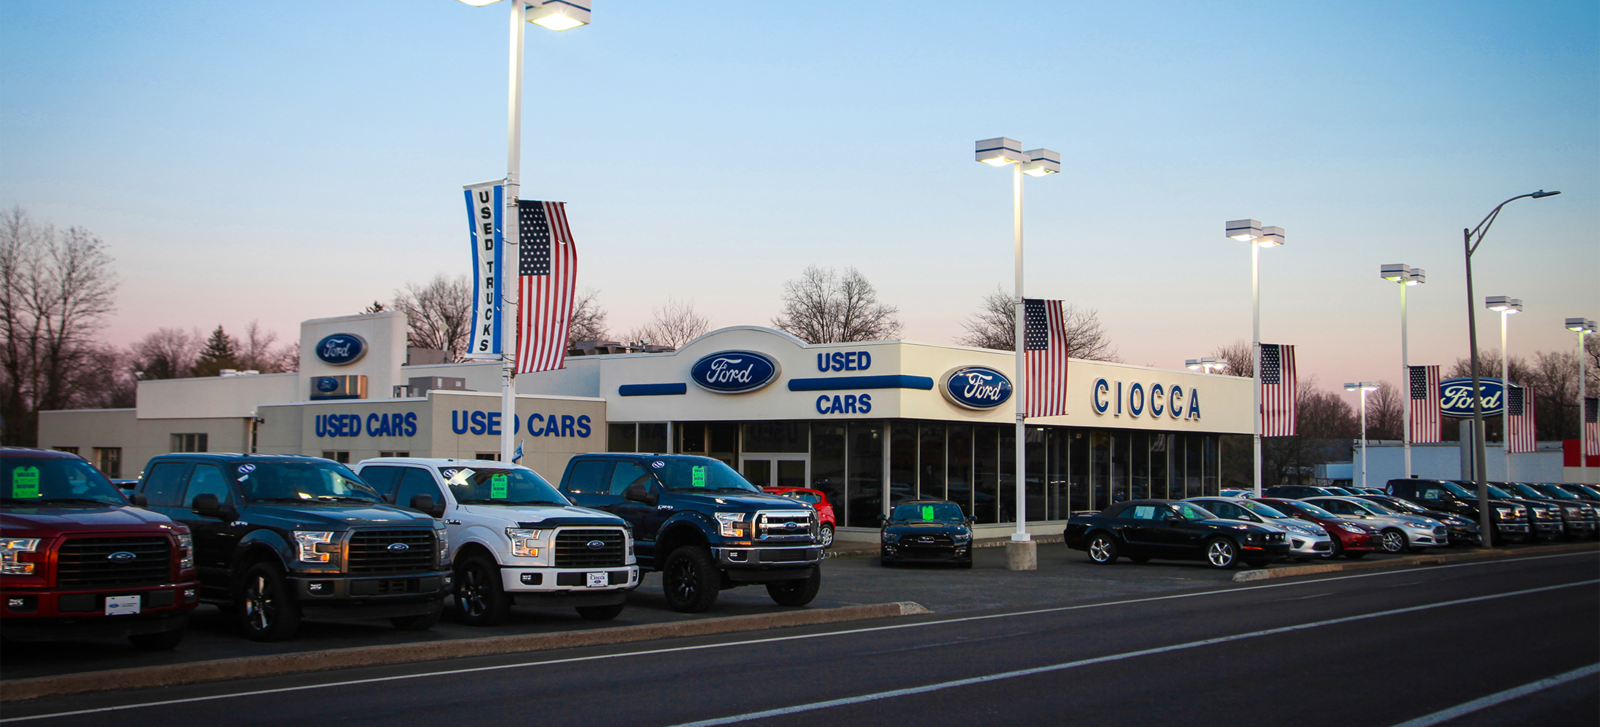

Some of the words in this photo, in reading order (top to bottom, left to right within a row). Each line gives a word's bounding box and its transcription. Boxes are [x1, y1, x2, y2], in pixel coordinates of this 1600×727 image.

[479, 191, 494, 251] USED
[479, 261, 494, 351] TRUCKS
[323, 338, 351, 358] Ford
[706, 357, 754, 383] Ford
[816, 351, 872, 372] USED
[963, 372, 1002, 401] Ford
[1092, 377, 1202, 420] CIOCCA
[1440, 385, 1502, 409] Ford
[815, 393, 872, 415] CARS
[315, 414, 362, 438] USED
[366, 412, 418, 437] CARS
[527, 412, 592, 438] CARS
